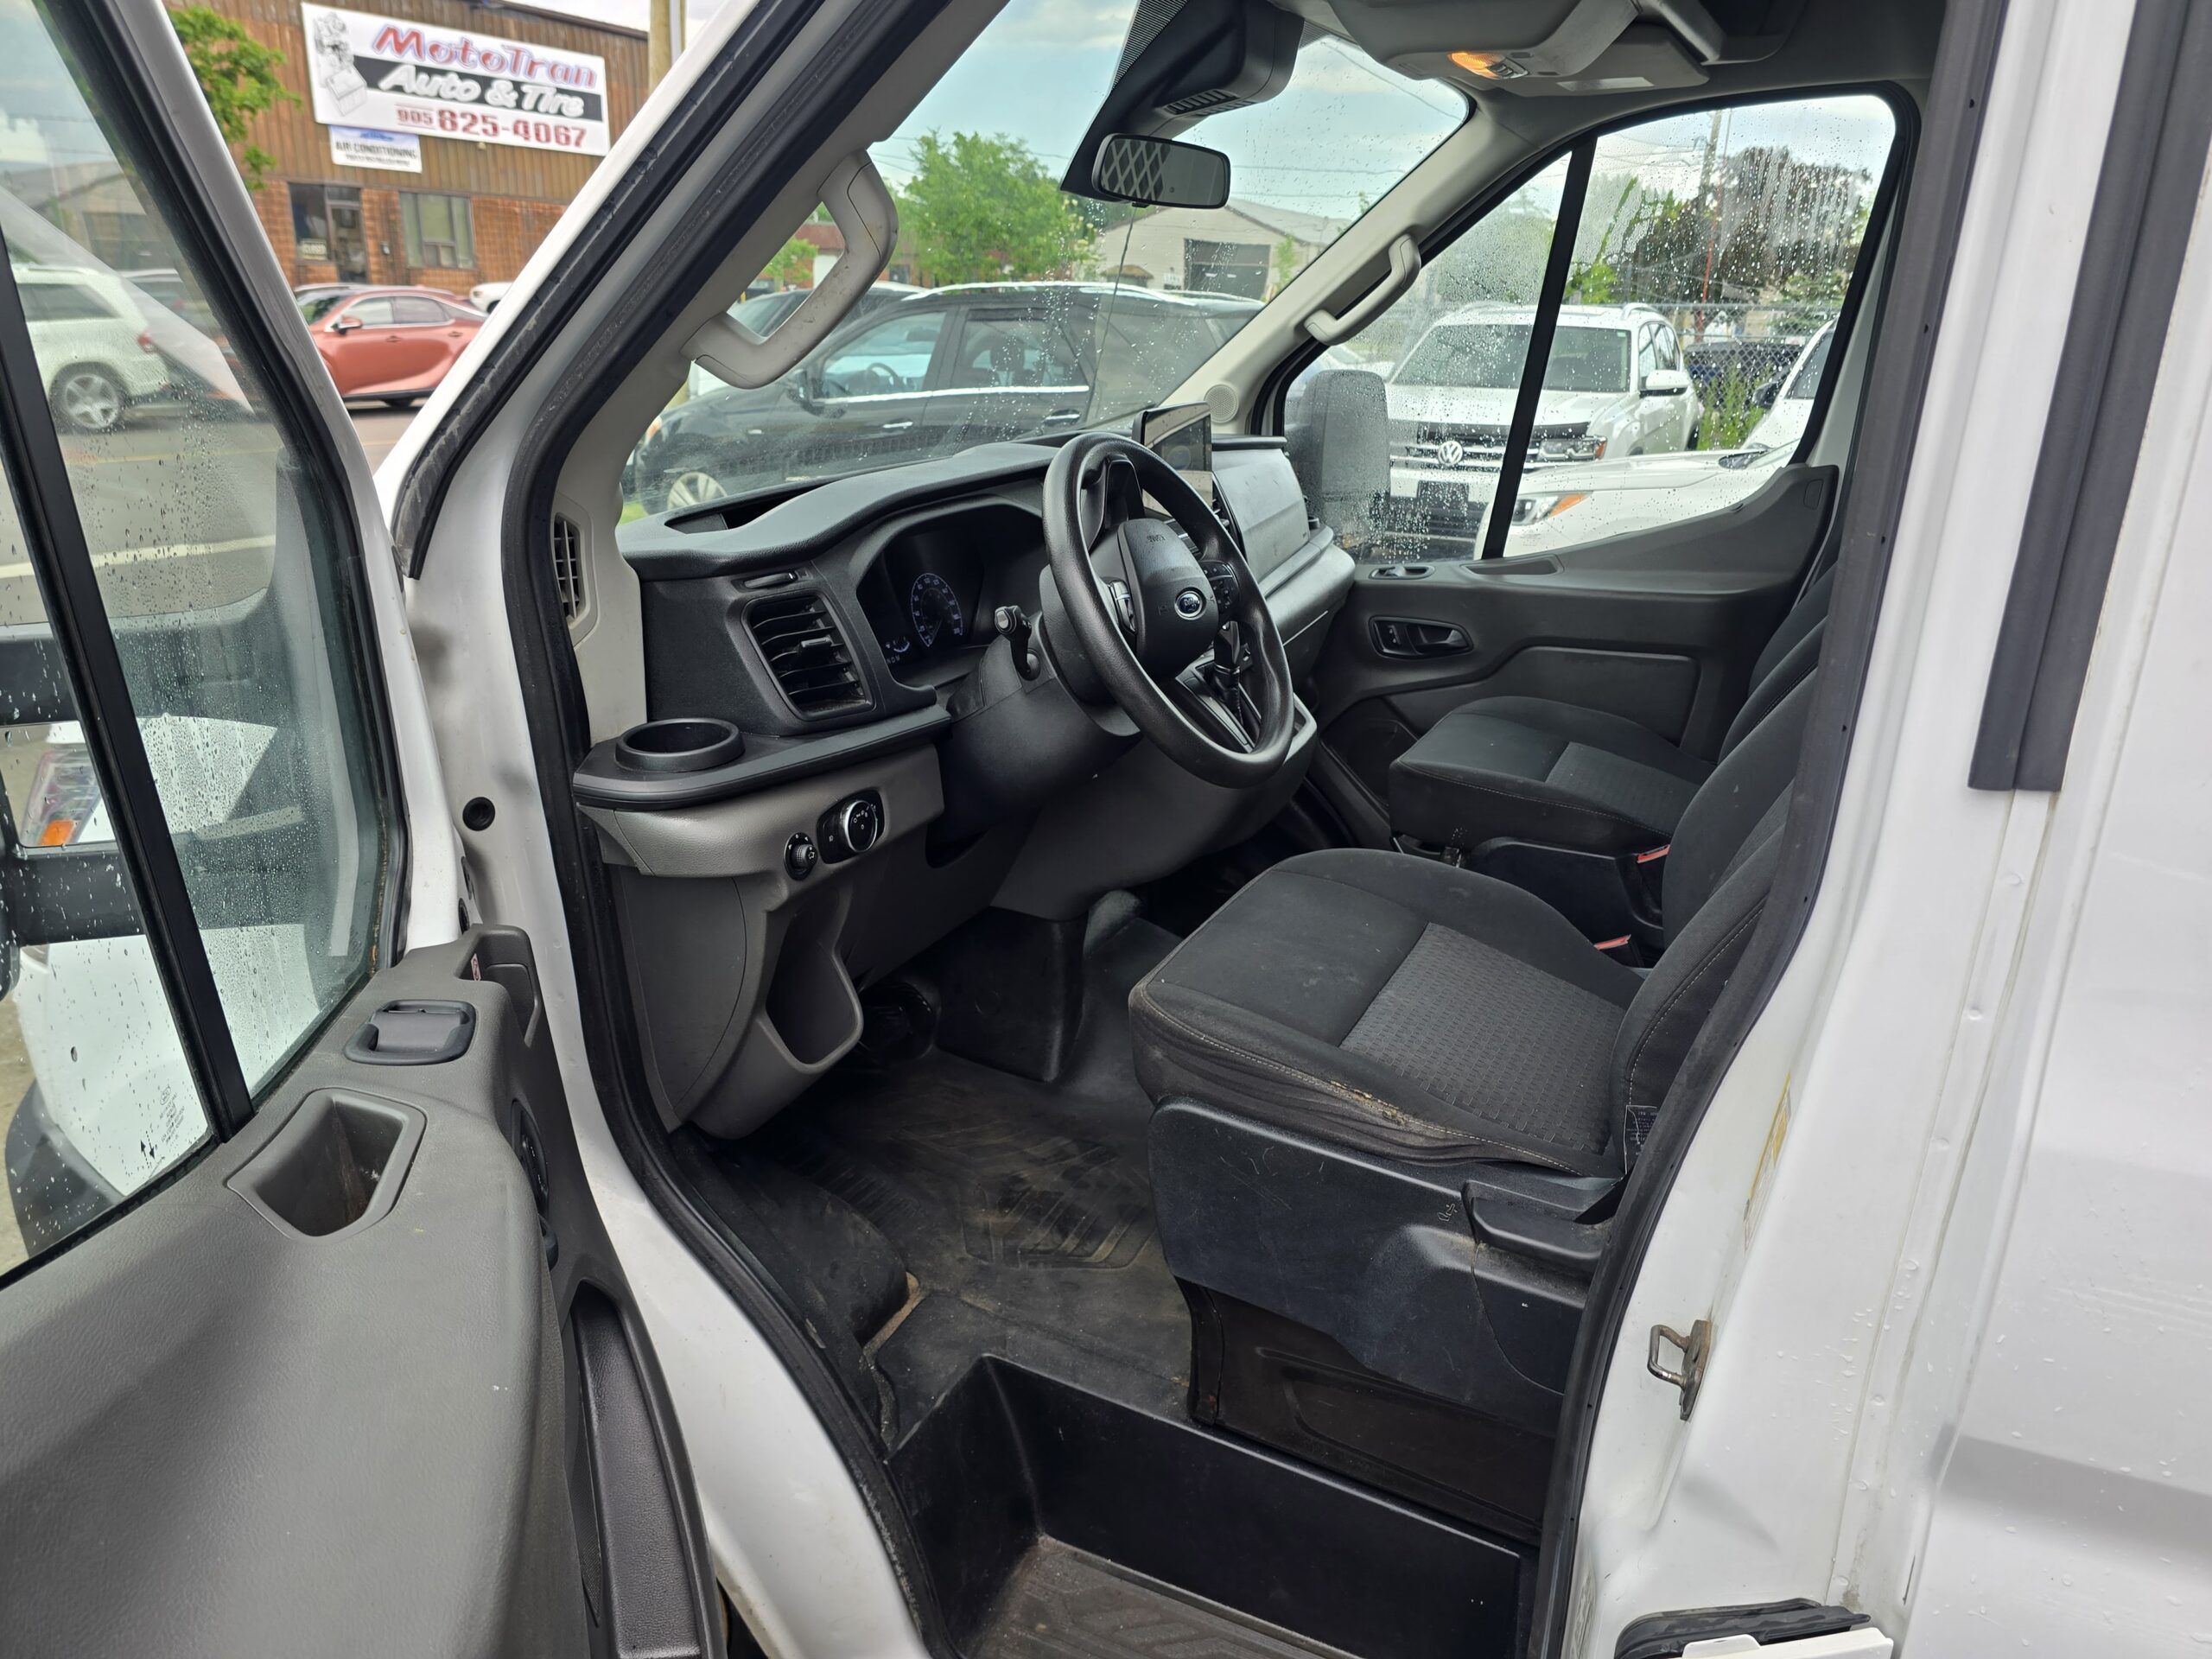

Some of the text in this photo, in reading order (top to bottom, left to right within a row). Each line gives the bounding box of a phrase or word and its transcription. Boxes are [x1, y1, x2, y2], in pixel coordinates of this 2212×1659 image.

[378, 64, 584, 118] Auto & Tire
[397, 109, 433, 125] 905
